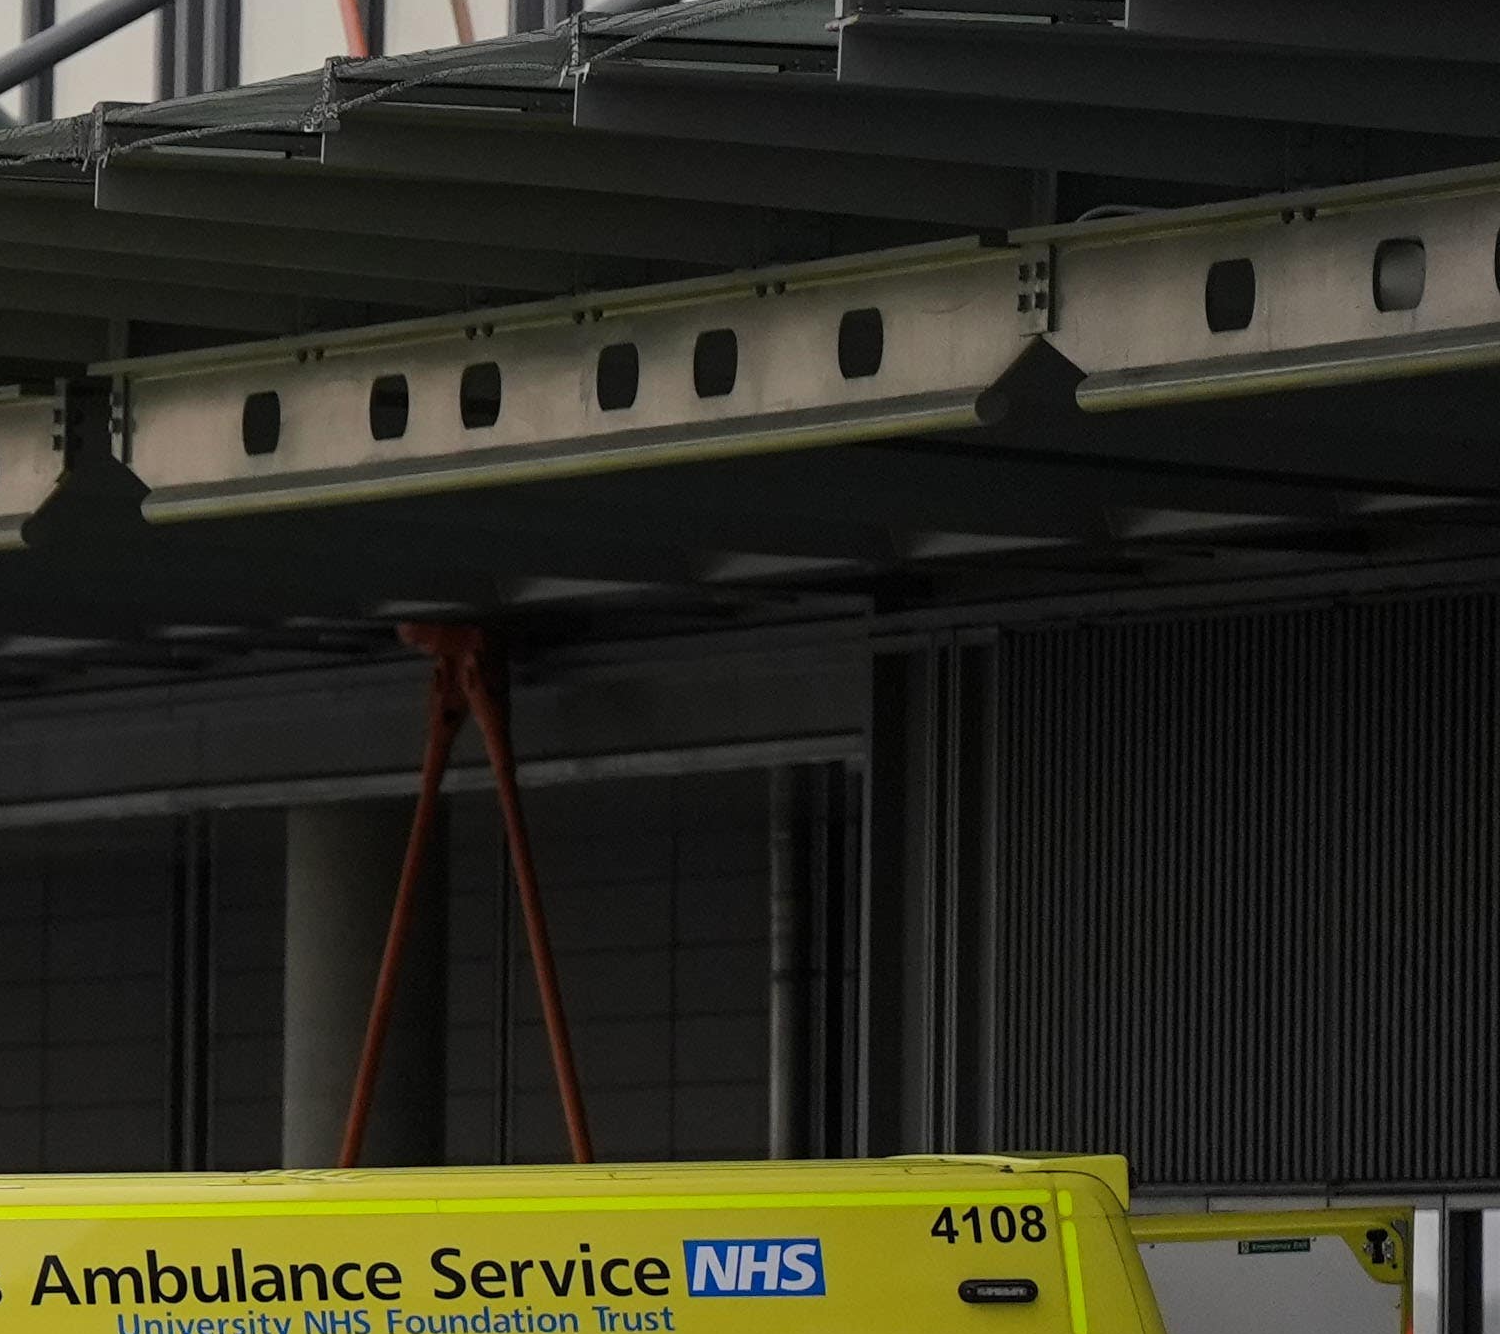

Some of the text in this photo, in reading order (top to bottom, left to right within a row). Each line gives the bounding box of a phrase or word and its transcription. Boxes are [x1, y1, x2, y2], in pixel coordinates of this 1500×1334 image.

[931, 1205, 1046, 1244] 4108
[31, 1248, 402, 1305] Ambulance
[431, 1243, 670, 1299] Service
[692, 1243, 819, 1293] NHS
[387, 1306, 579, 1334] Foundation
[592, 1306, 675, 1331] Trust
